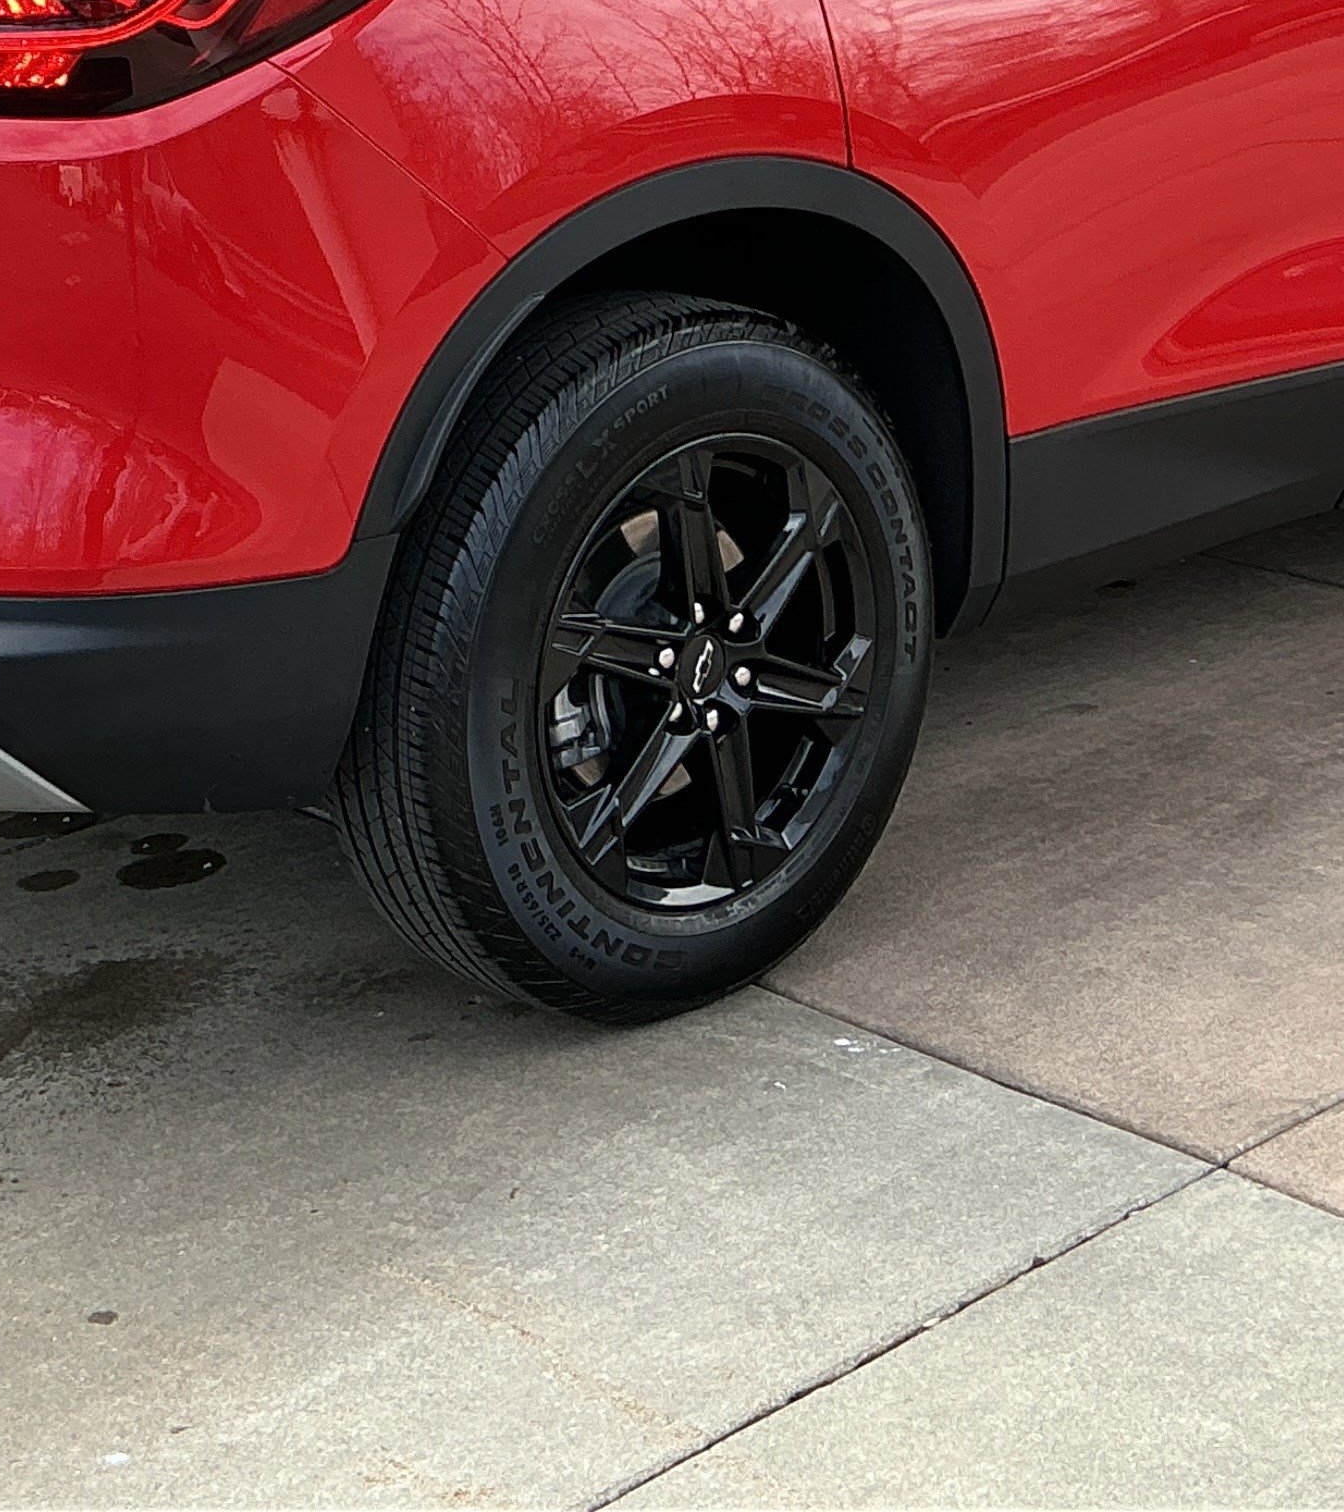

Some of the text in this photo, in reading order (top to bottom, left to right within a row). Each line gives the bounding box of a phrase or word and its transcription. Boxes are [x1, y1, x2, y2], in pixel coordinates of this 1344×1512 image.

[612, 384, 670, 431] SPORT
[865, 461, 918, 664] CONTACT
[500, 677, 687, 971] CONTINENTAL
